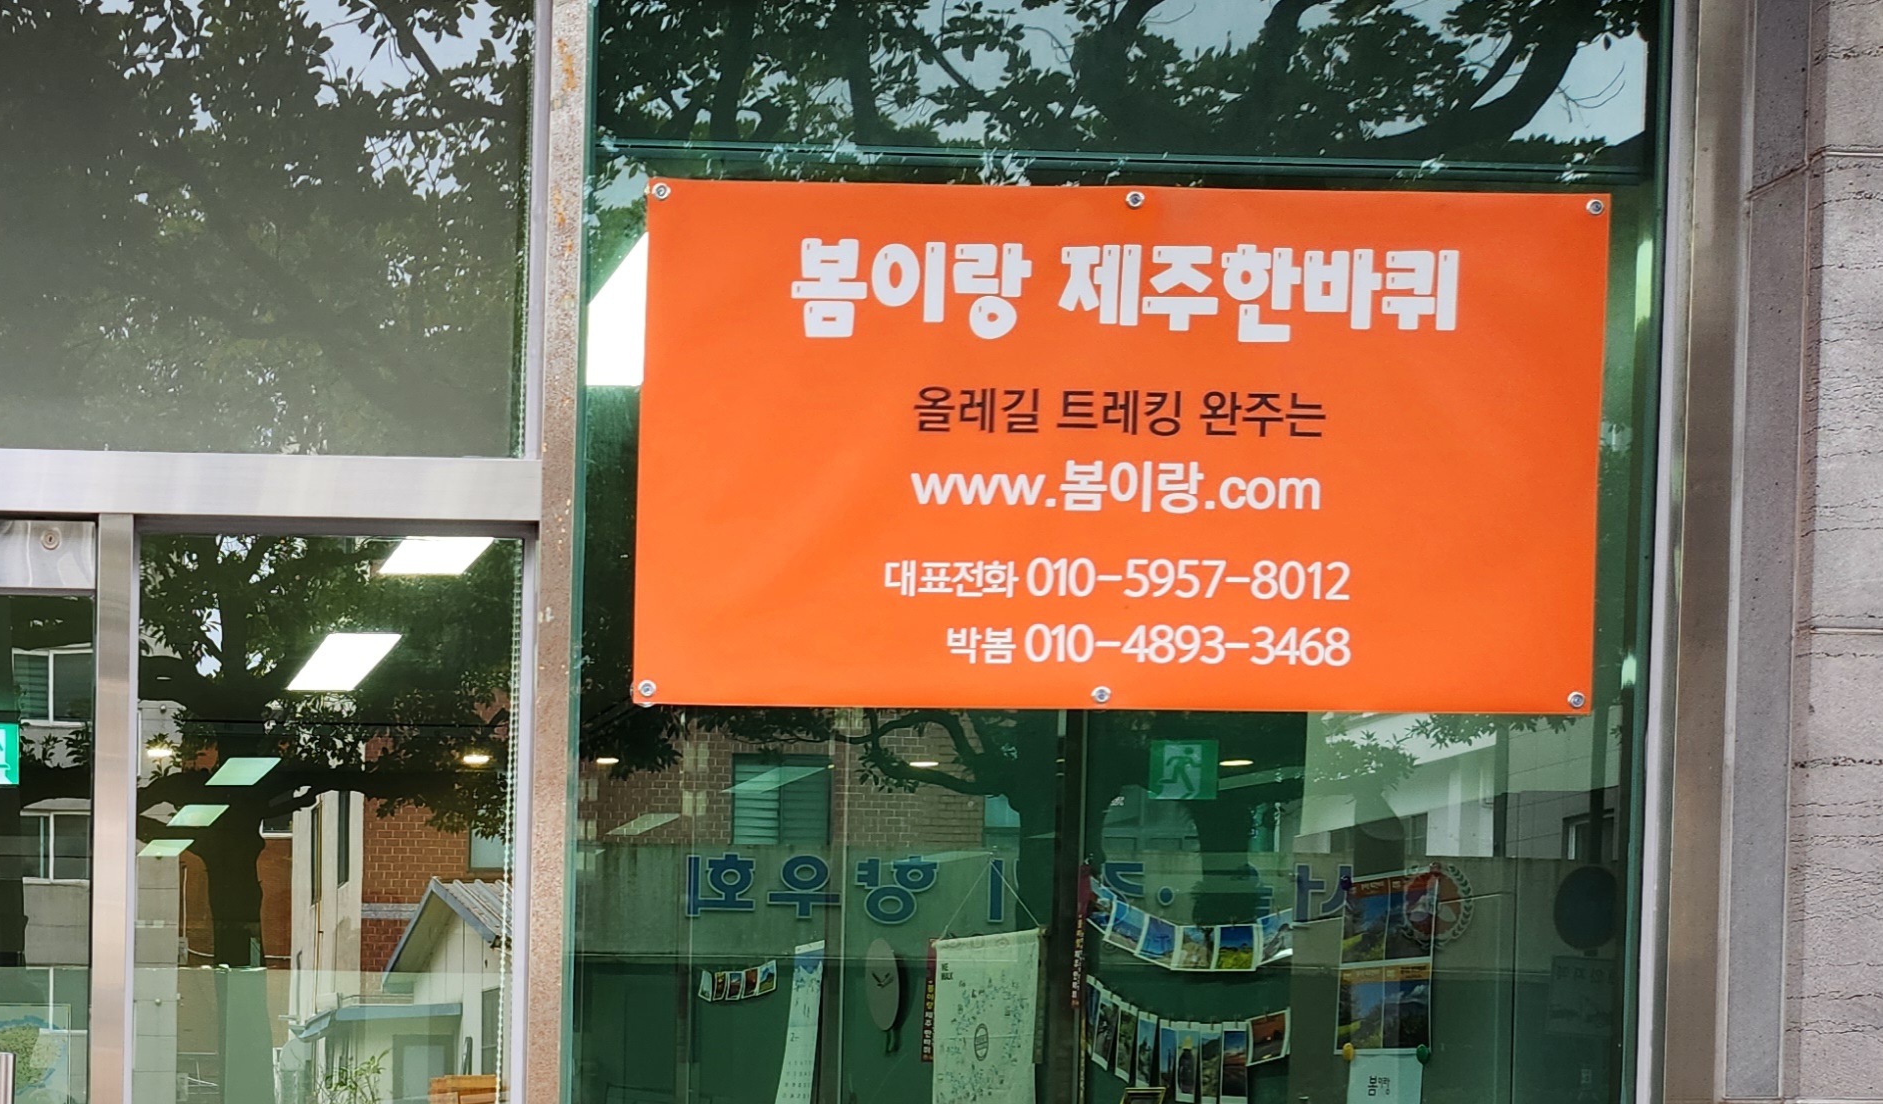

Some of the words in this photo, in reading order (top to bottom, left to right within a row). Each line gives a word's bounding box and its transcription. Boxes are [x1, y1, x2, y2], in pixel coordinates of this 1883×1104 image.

[790, 237, 1031, 340] 봄이랑
[1058, 243, 1460, 343] 제주한바퀴
[913, 386, 1042, 435] 올레길
[1054, 388, 1182, 437] 트레킹
[1198, 390, 1327, 439] 완주는
[911, 460, 1320, 515] www.봄이랑.com
[883, 559, 1018, 600] 대표전화
[1025, 557, 1350, 602] 010-5957-8012
[946, 625, 1016, 666] 박봄
[1024, 623, 1351, 668] 010-4893-3468
